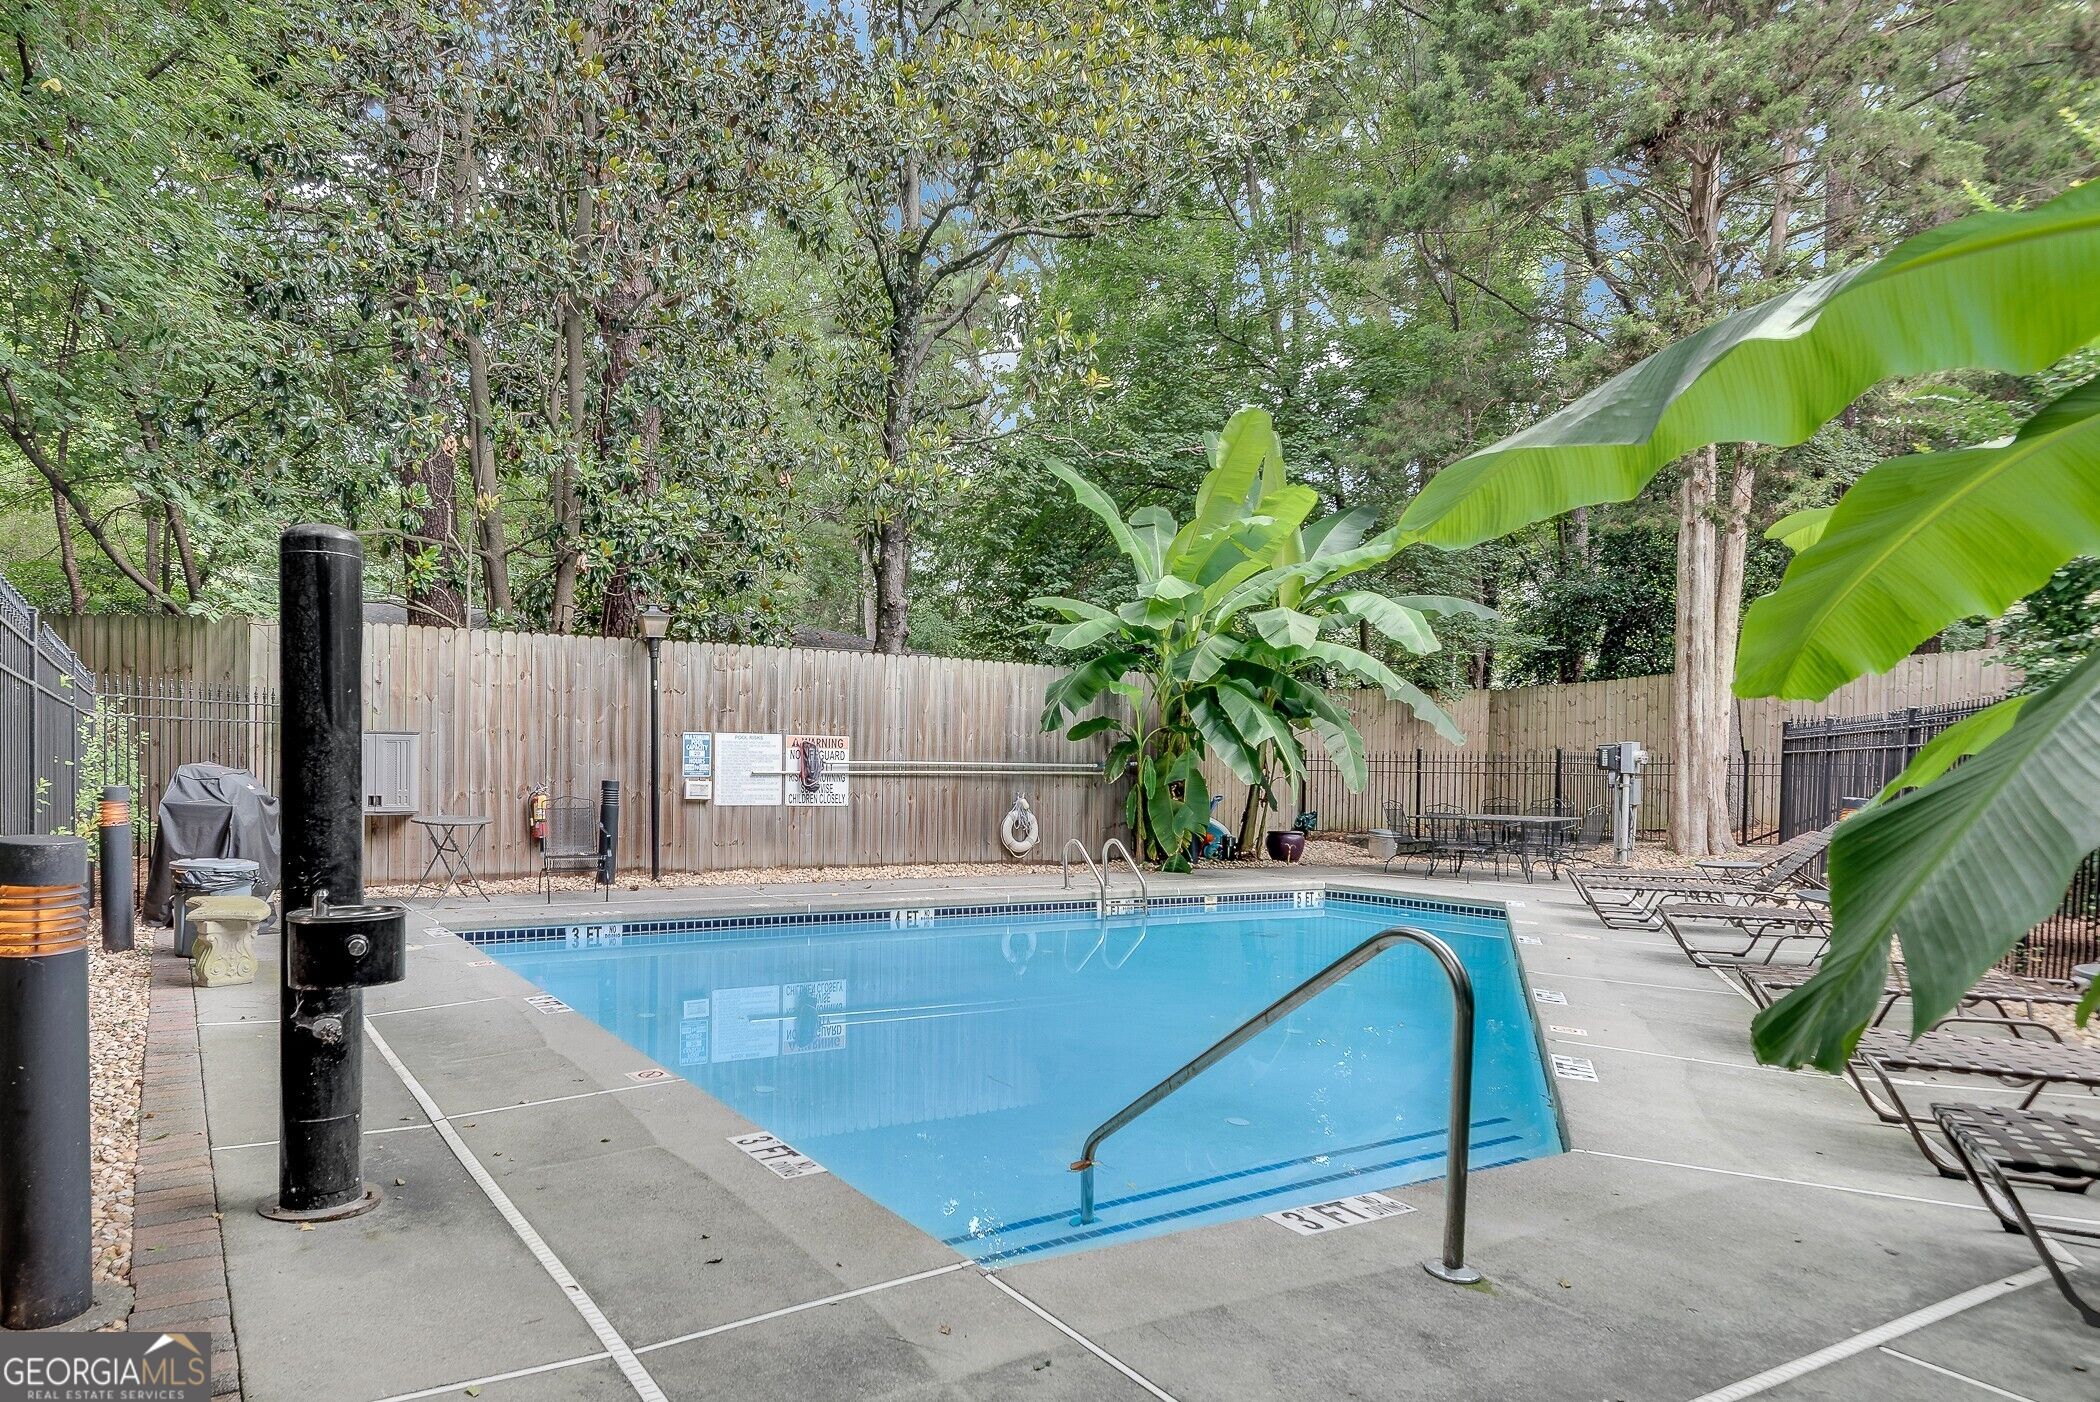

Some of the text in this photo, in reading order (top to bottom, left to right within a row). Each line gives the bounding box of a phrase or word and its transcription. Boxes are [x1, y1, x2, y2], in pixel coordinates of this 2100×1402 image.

[788, 794, 846, 803] CHILDREN CLOSELY
[906, 910, 919, 920] FT
[571, 926, 602, 939] 3 FT
[749, 1145, 801, 1160] FT
[1308, 1201, 1370, 1224] FT
